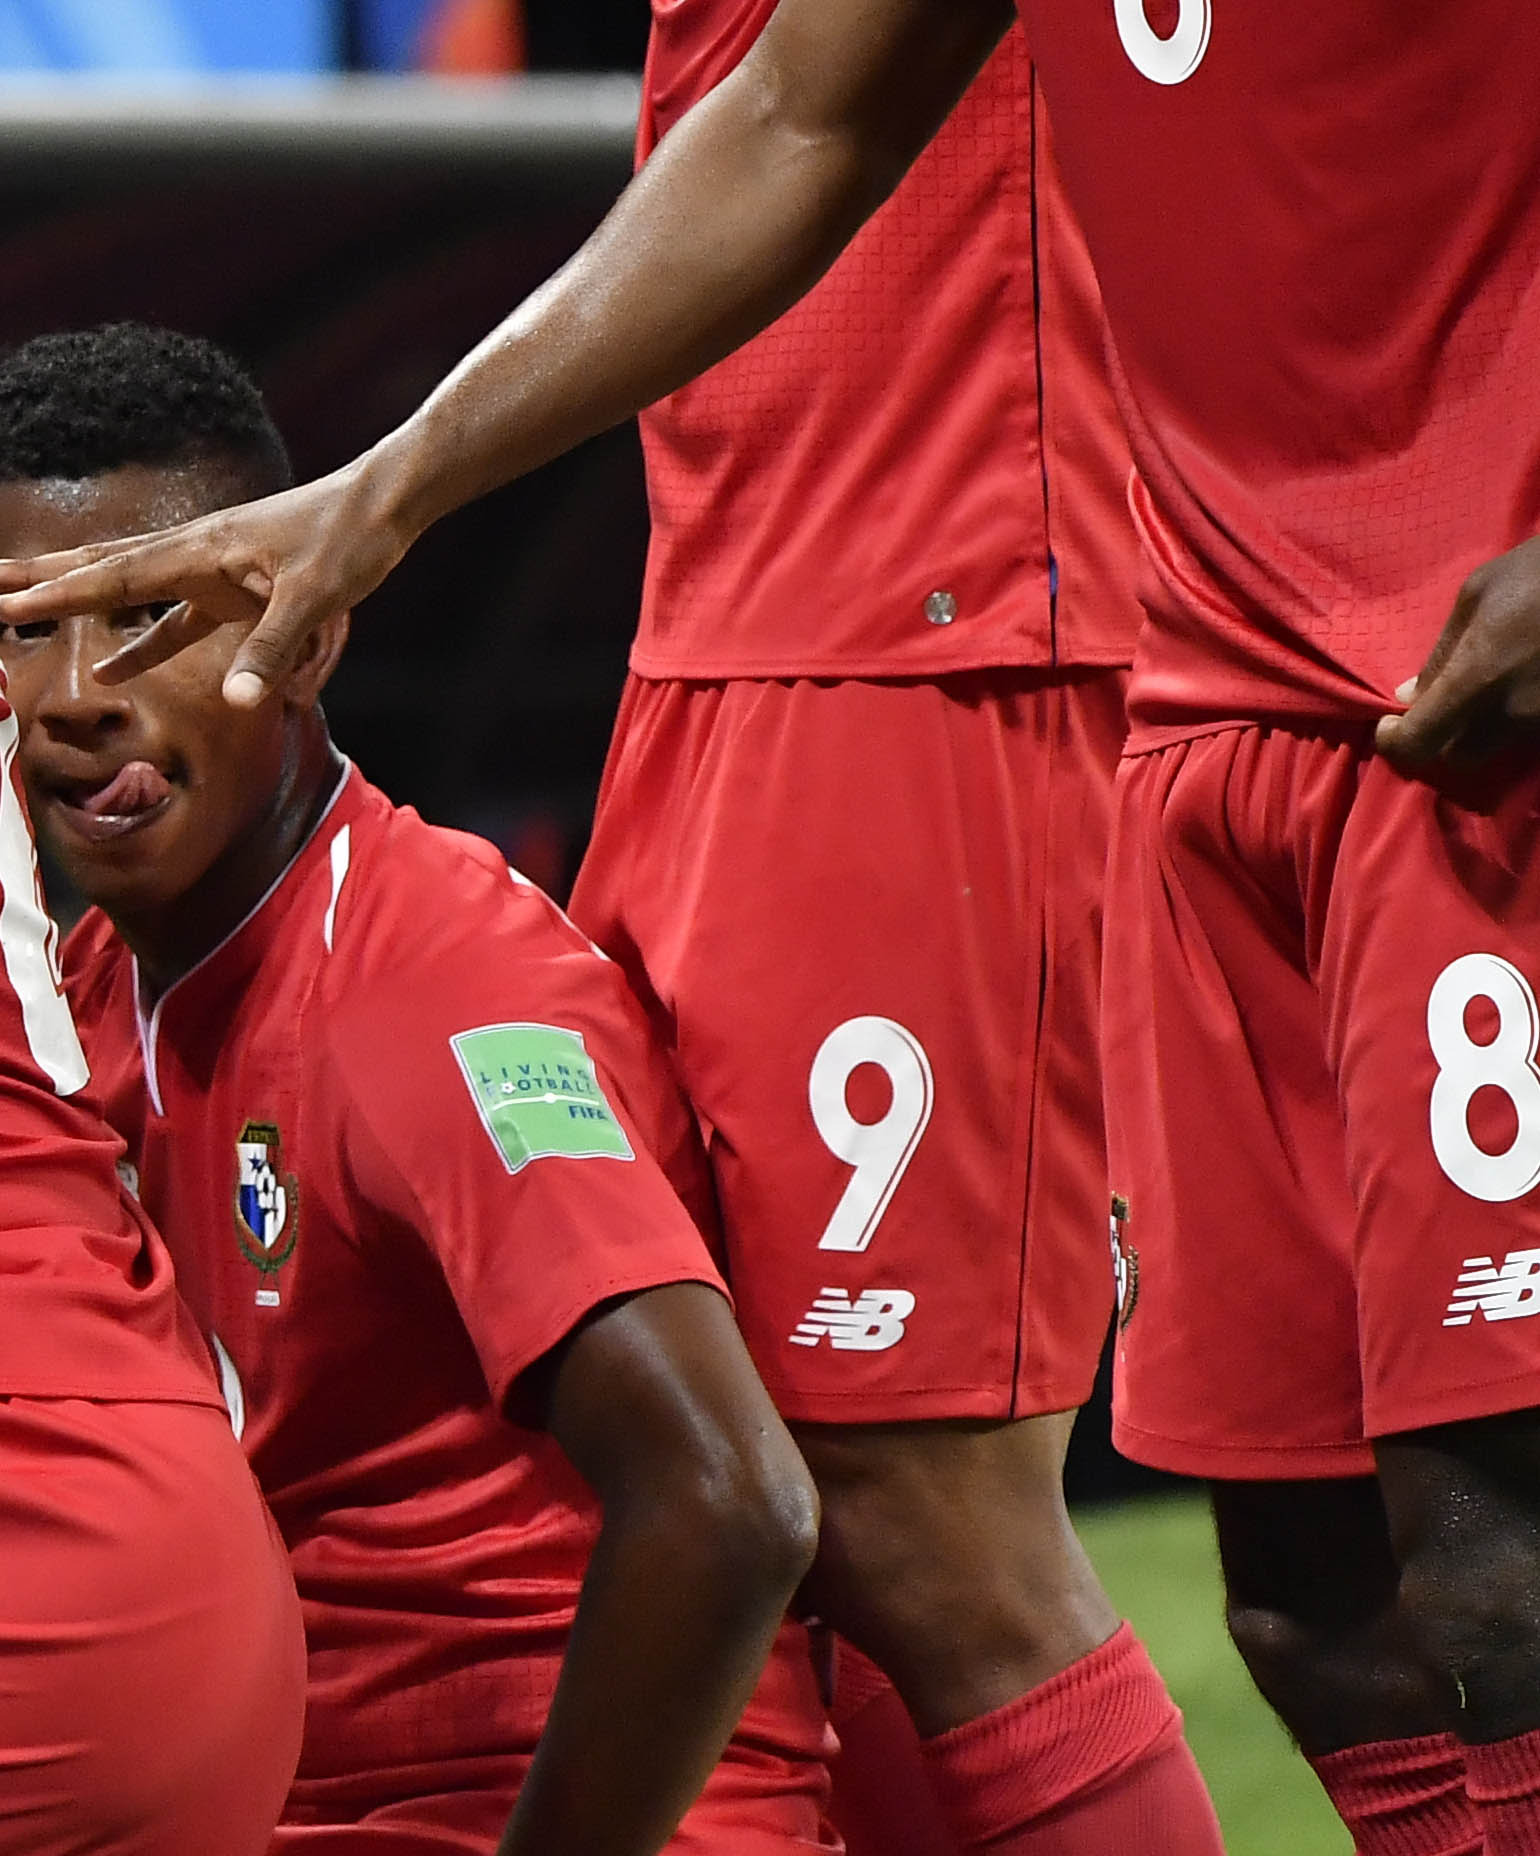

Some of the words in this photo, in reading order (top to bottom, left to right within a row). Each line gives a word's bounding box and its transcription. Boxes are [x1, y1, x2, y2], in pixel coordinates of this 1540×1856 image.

[480, 1062, 589, 1084] LIVING
[1427, 952, 1540, 1202] 8
[568, 1104, 608, 1120] FIFA
[808, 1015, 935, 1253] 9
[788, 1287, 916, 1351] NB
